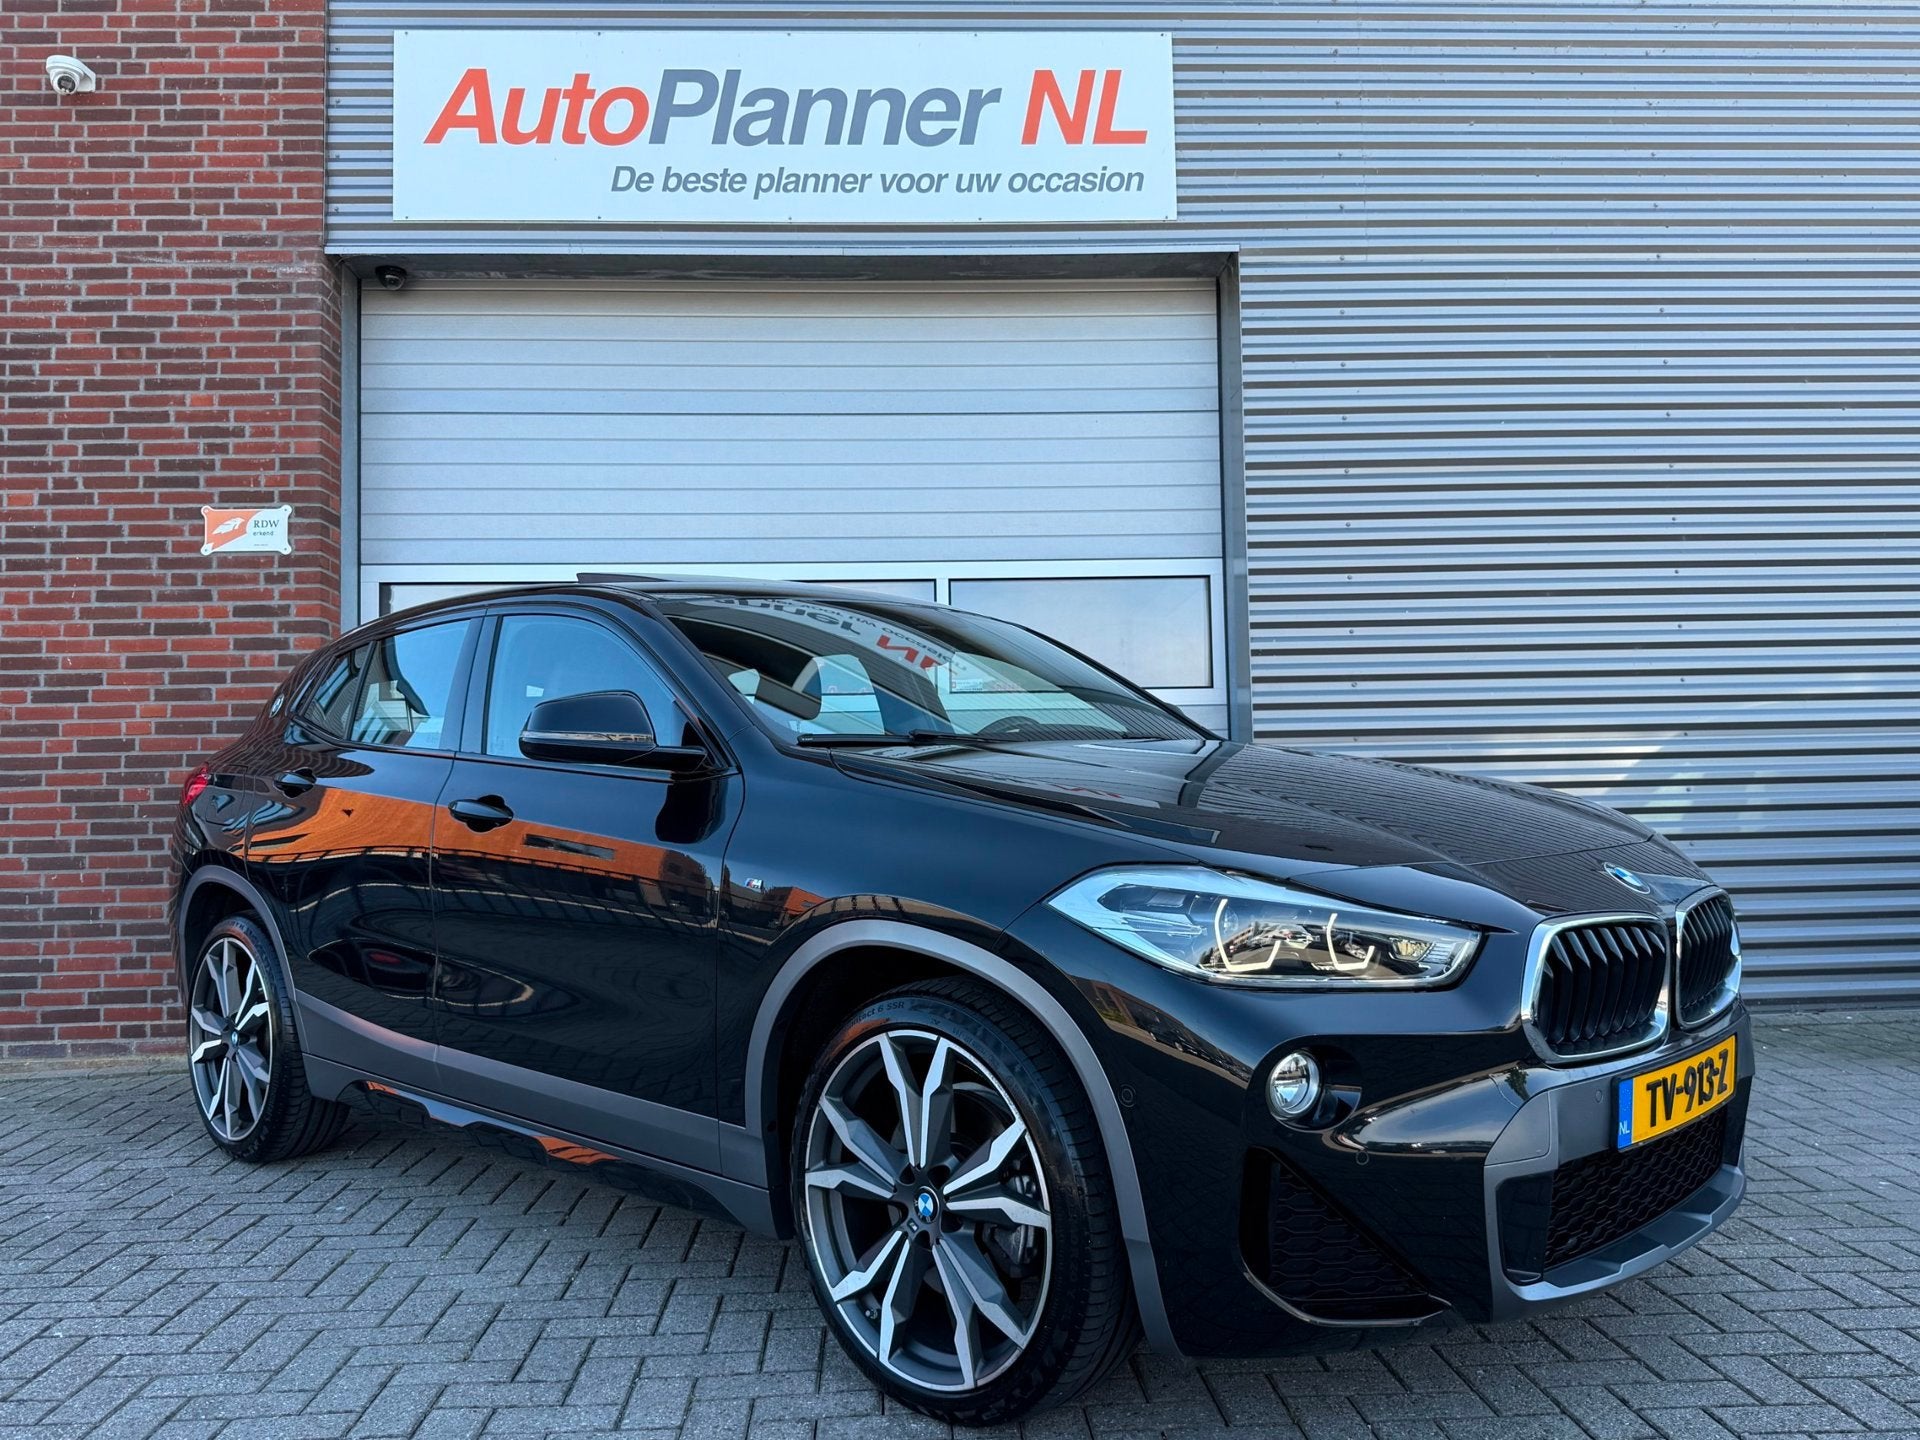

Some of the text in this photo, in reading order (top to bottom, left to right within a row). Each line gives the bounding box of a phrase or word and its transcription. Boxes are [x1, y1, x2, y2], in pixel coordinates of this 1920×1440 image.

[424, 69, 1148, 146] AutoPlanner NL
[611, 165, 1145, 200] De beste planner voor uw occasion
[253, 519, 280, 529] RDW
[1646, 1048, 1729, 1128] TV-913-Z
[1619, 1120, 1631, 1135] NL
